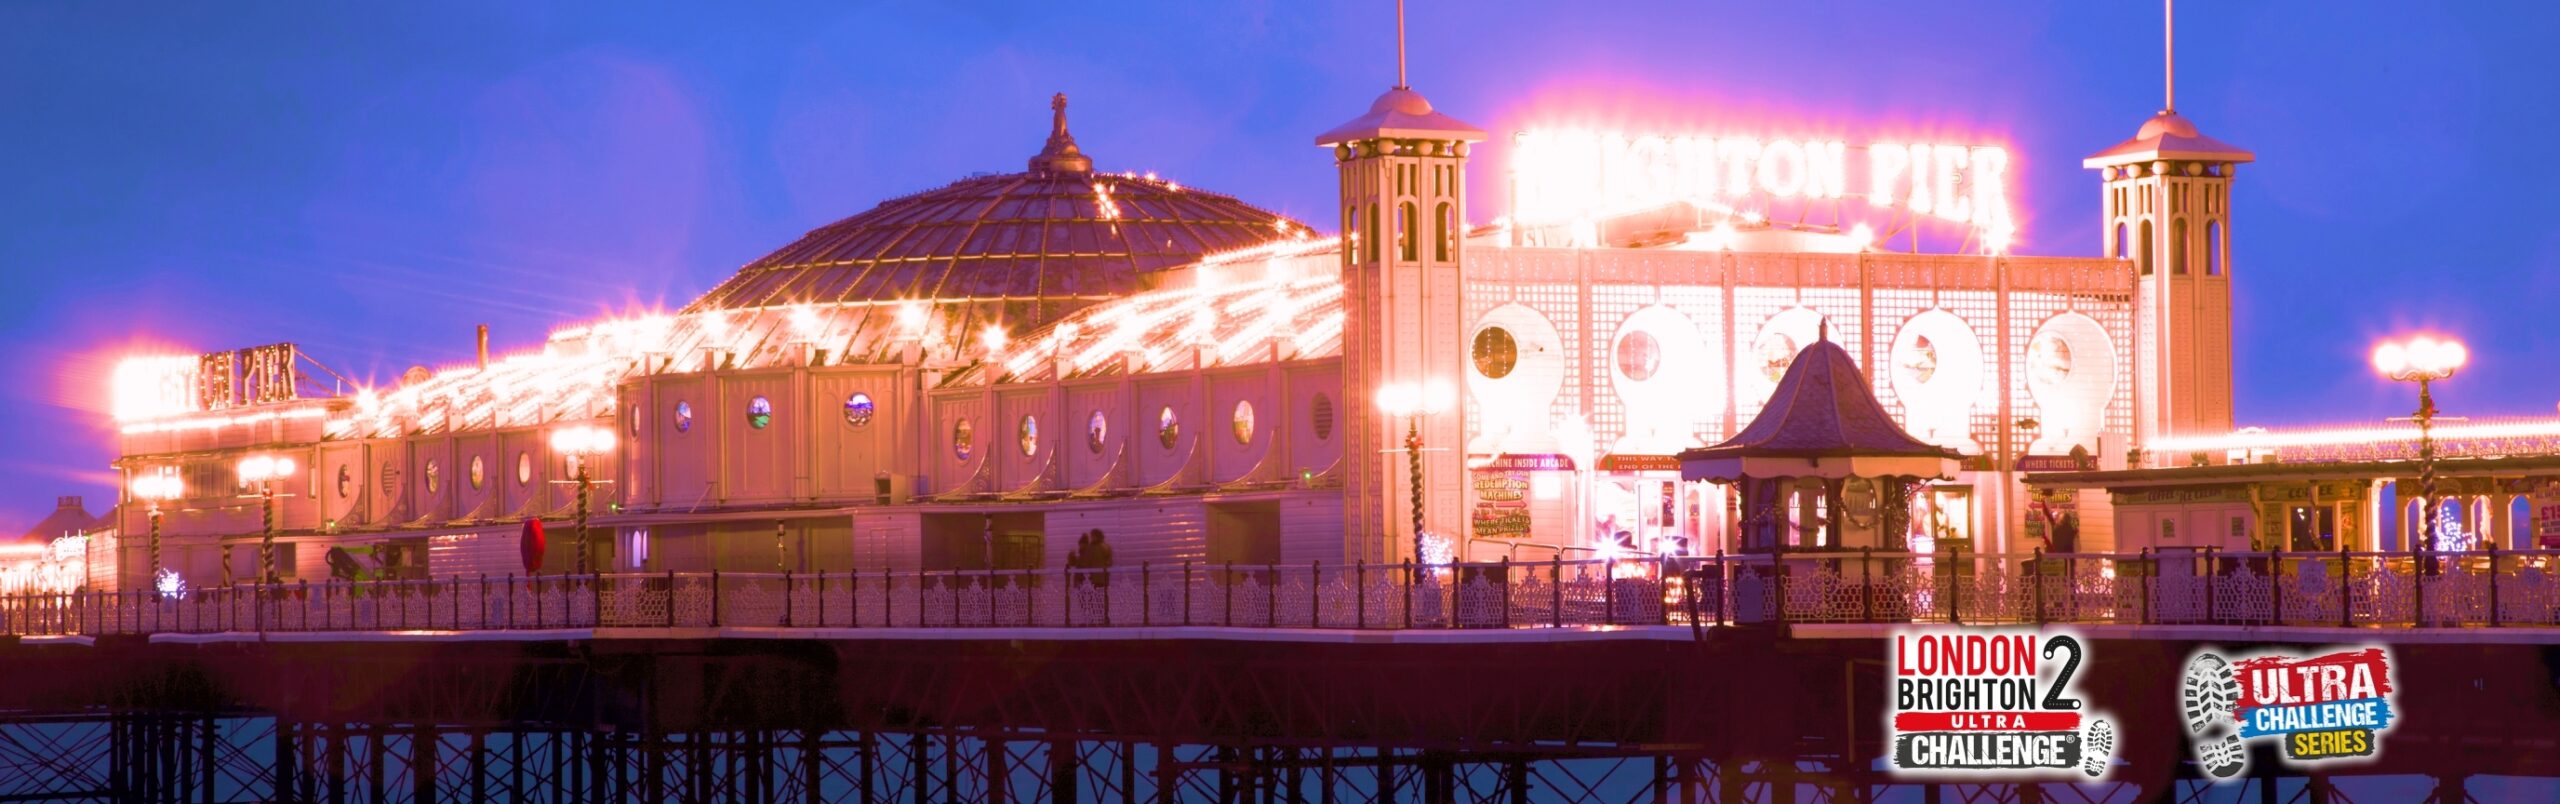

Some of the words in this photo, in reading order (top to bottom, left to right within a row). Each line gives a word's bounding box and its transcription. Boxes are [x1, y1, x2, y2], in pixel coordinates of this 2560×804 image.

[1514, 129, 1845, 219] IGHTON
[1869, 143, 2013, 234] PIER
[241, 342, 297, 405] PIER
[1514, 458, 1538, 468] INSIDE
[1540, 458, 1568, 468] ARCADE
[2025, 459, 2047, 469] WHERE
[2049, 459, 2074, 469] TICKETS
[1473, 478, 1528, 490] REDEMPTION
[1480, 490, 1523, 500] MACHINES
